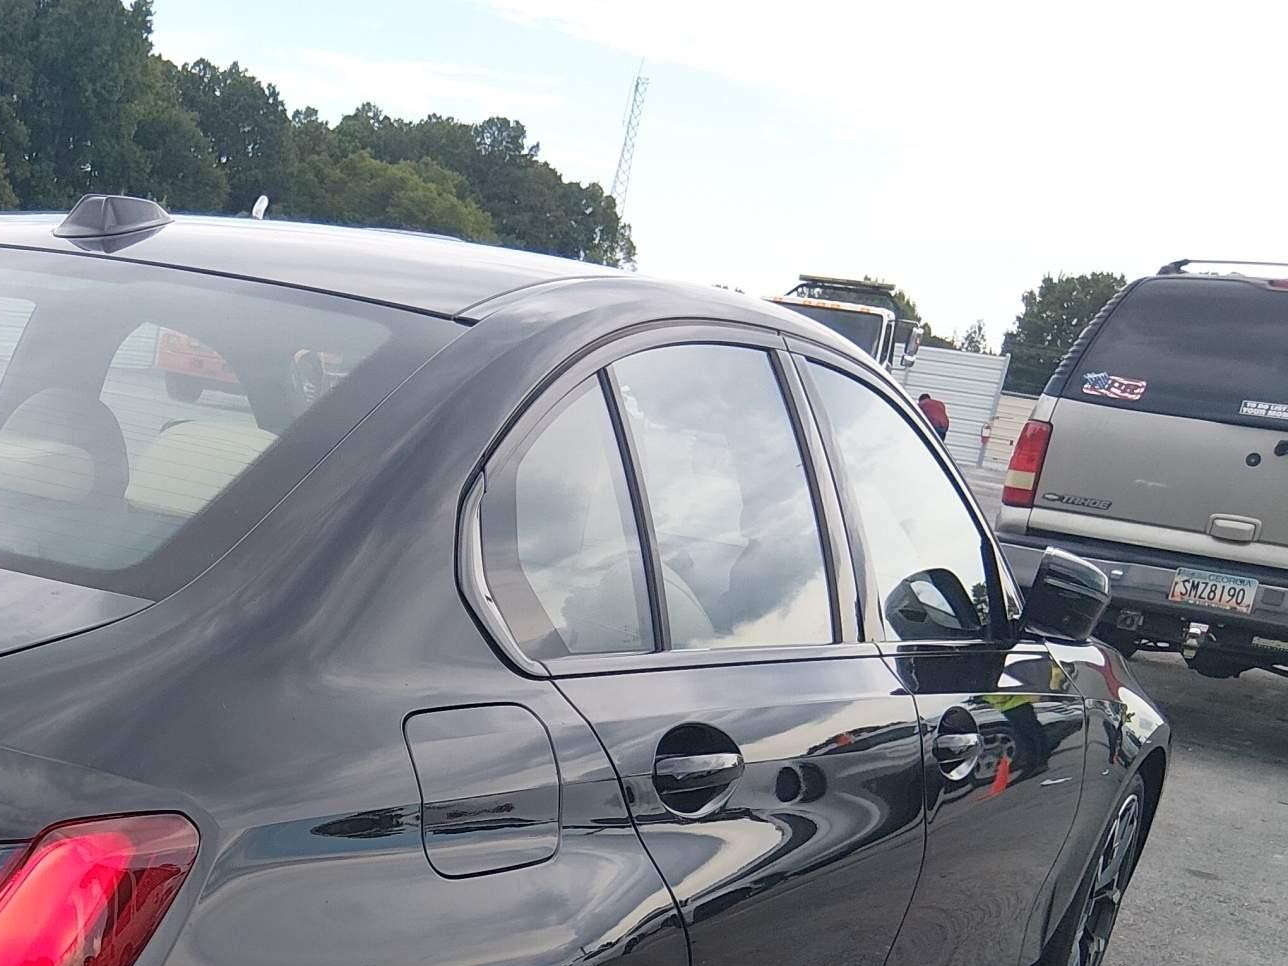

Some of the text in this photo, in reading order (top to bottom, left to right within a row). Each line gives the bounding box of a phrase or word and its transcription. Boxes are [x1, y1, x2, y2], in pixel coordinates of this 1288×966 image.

[1062, 496, 1111, 510] TAHOE
[1208, 573, 1252, 587] GEORGIA
[1180, 579, 1246, 605] SMZ8190
